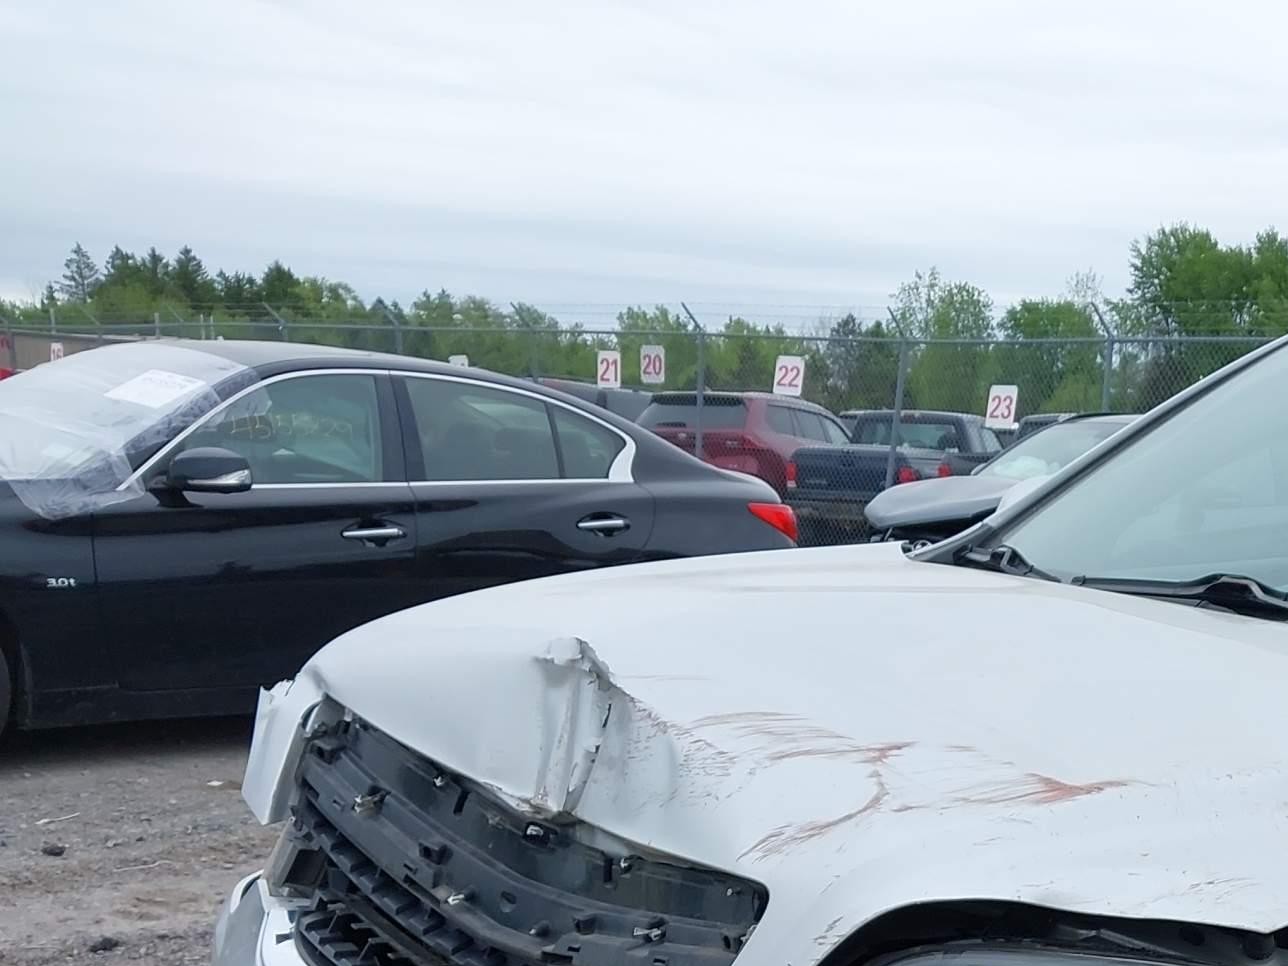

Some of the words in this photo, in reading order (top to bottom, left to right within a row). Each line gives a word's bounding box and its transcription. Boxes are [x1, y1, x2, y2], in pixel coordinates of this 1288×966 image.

[599, 357, 619, 382] 21
[642, 353, 663, 376] 20
[776, 364, 801, 388] 22
[989, 394, 1014, 420] 23
